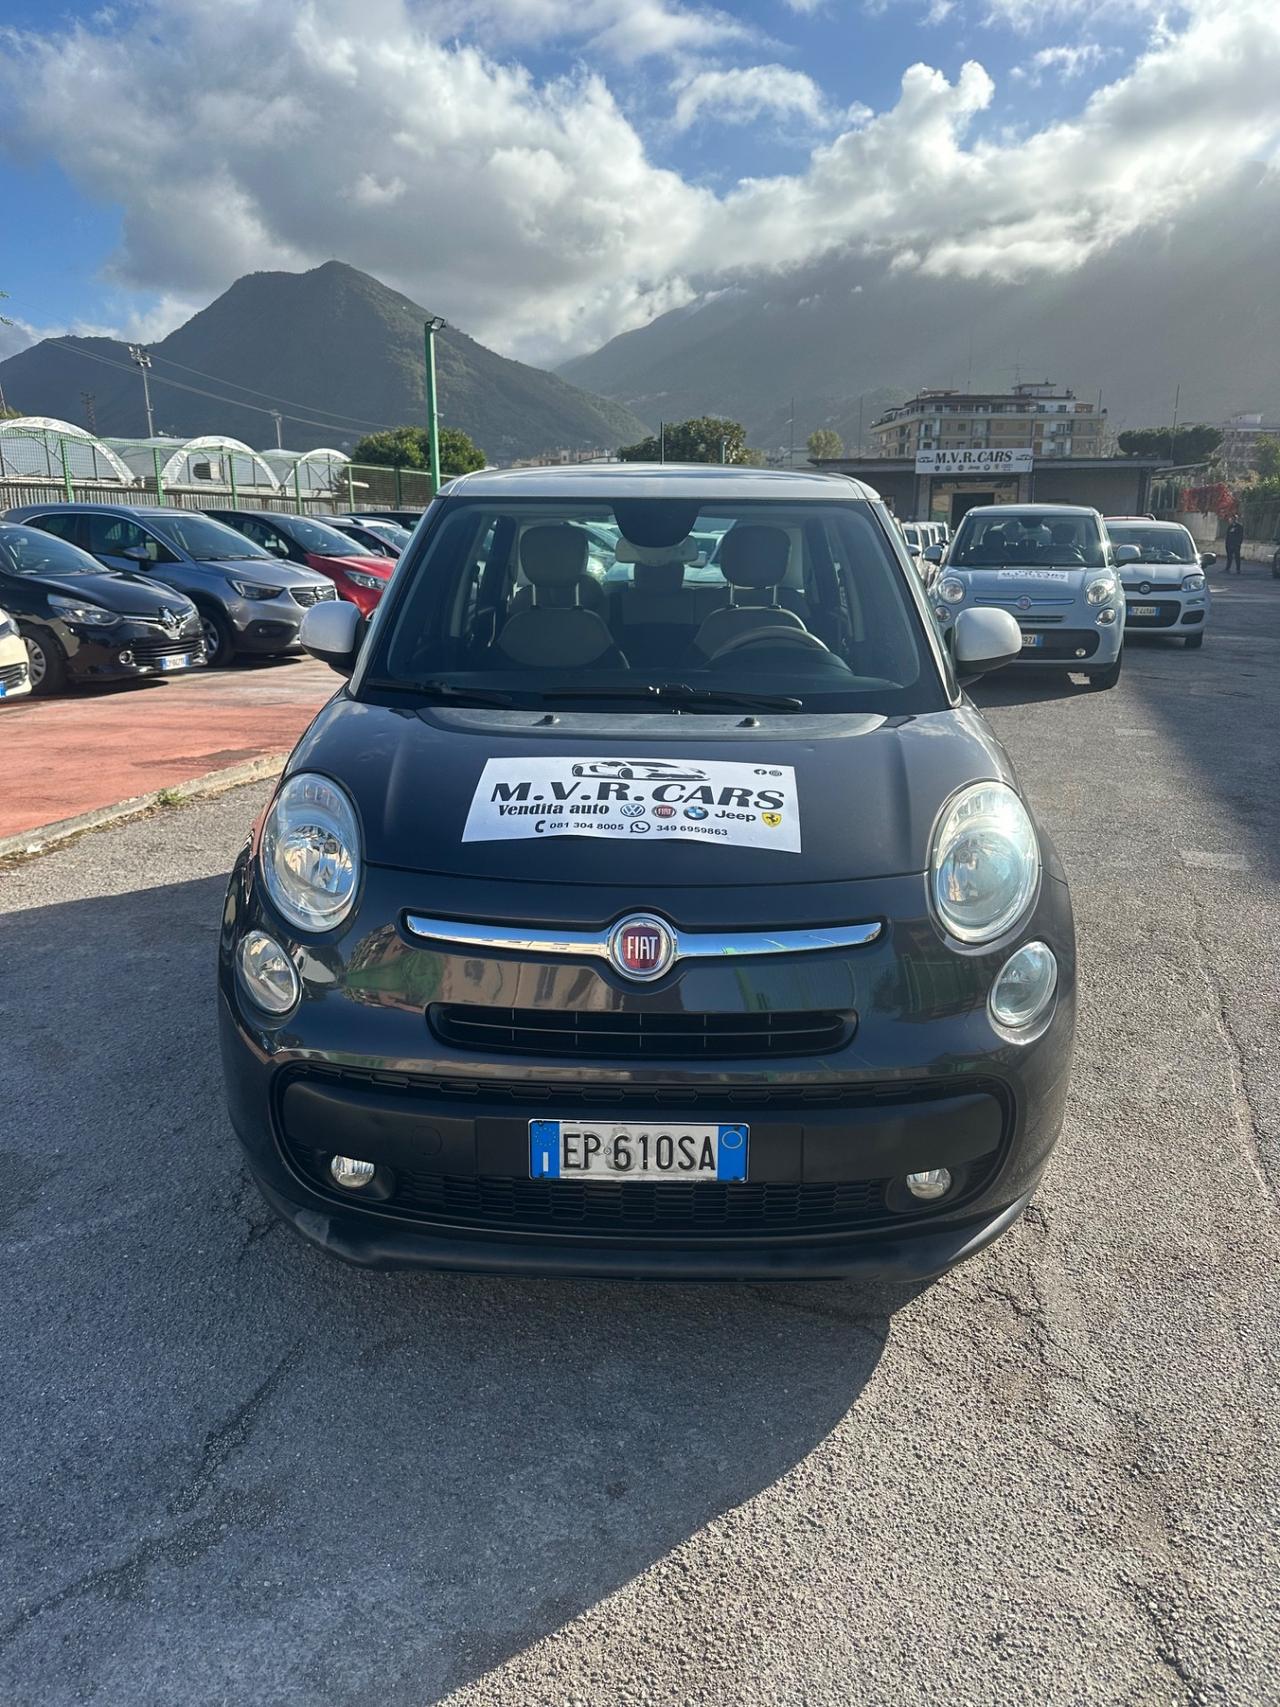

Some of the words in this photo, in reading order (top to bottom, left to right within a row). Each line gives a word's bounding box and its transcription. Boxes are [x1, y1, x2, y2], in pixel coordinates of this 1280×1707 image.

[499, 802, 564, 816] Vendita
[569, 802, 610, 815] auto
[715, 809, 757, 822] Jeep
[596, 822, 624, 831] 8005
[656, 824, 677, 832] 349
[680, 825, 728, 836] 6959863
[627, 935, 659, 960] FIAT
